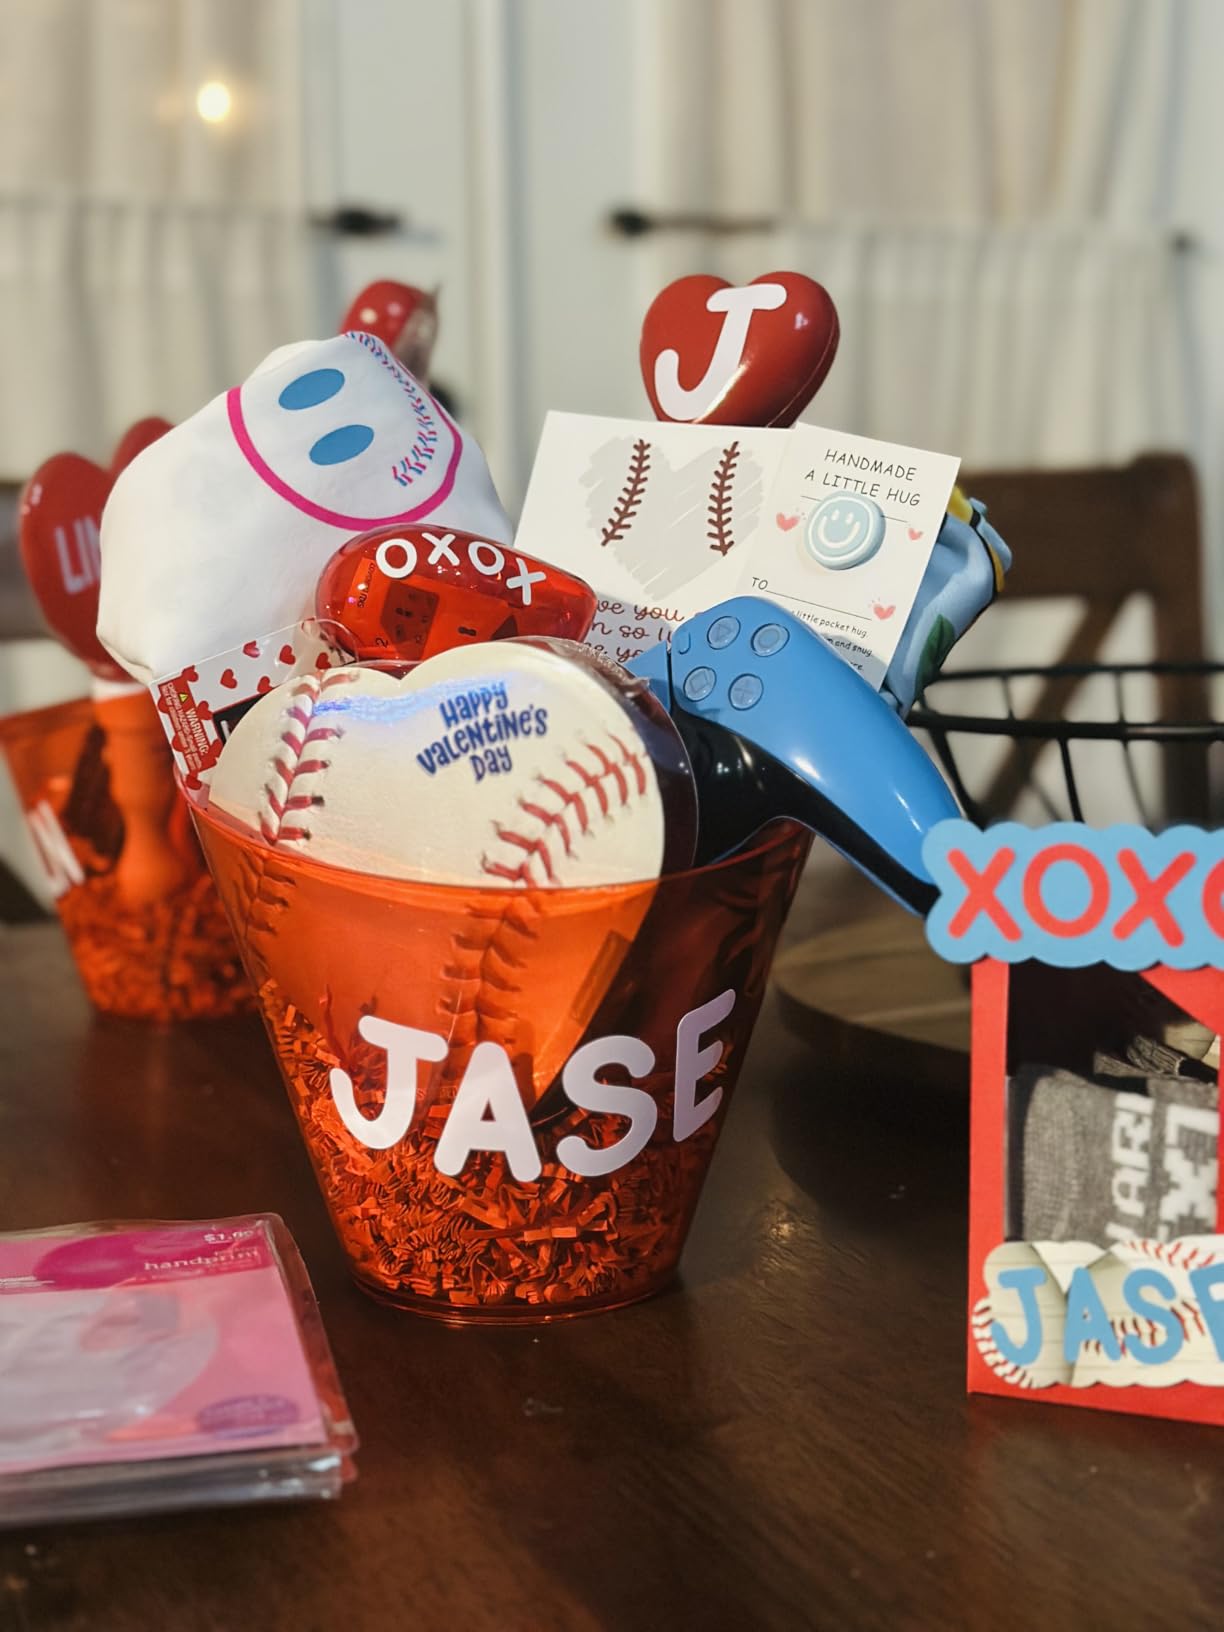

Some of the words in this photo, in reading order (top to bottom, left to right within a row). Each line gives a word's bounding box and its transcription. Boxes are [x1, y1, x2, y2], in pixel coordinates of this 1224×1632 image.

[654, 284, 787, 421] J
[824, 449, 917, 481] HANDMADE
[804, 469, 815, 481] A
[822, 472, 880, 497] LITTLE
[886, 487, 921, 507] HUG
[375, 532, 547, 606] OXOX
[752, 576, 768, 590] TO
[633, 604, 685, 622] you
[819, 618, 849, 633] pocket
[946, 842, 1224, 948] XOX
[329, 988, 736, 1183] JASE
